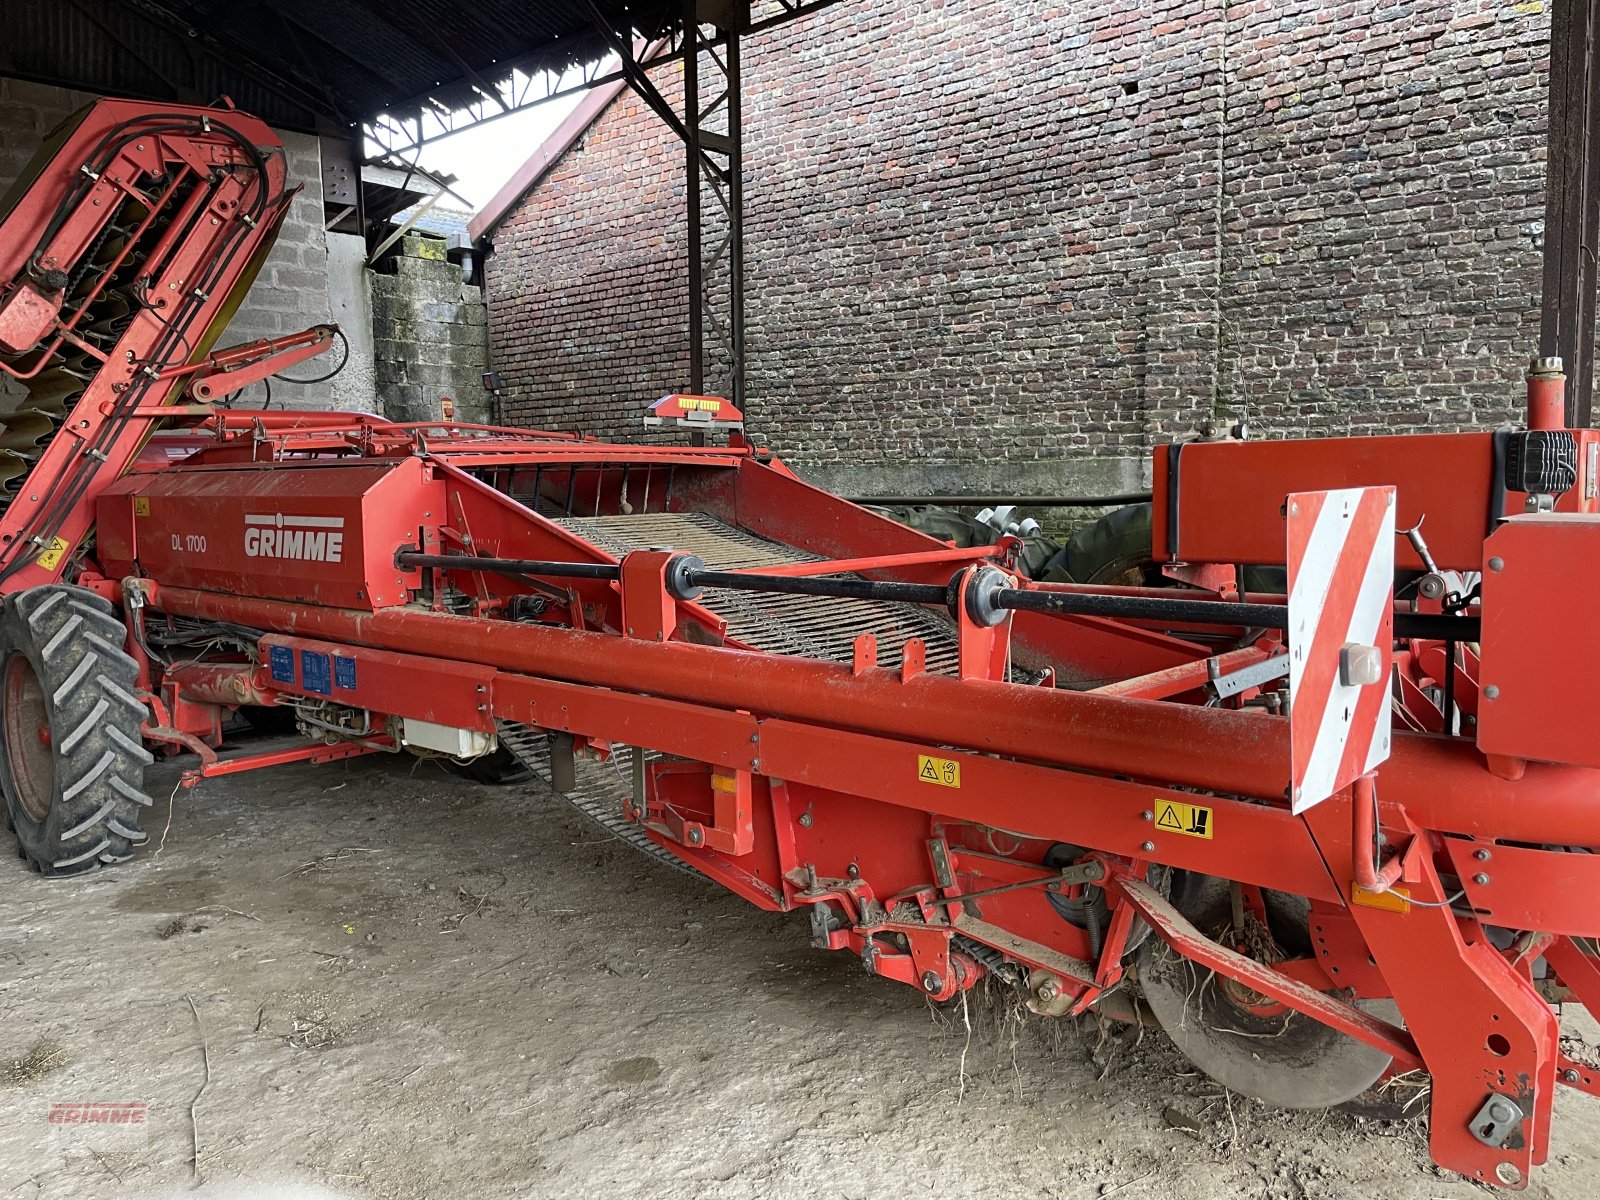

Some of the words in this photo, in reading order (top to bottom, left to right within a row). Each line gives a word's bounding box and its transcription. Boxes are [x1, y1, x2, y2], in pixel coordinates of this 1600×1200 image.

[171, 533, 183, 551] DL
[186, 534, 207, 553] 1700
[244, 512, 344, 563] GRIMME
